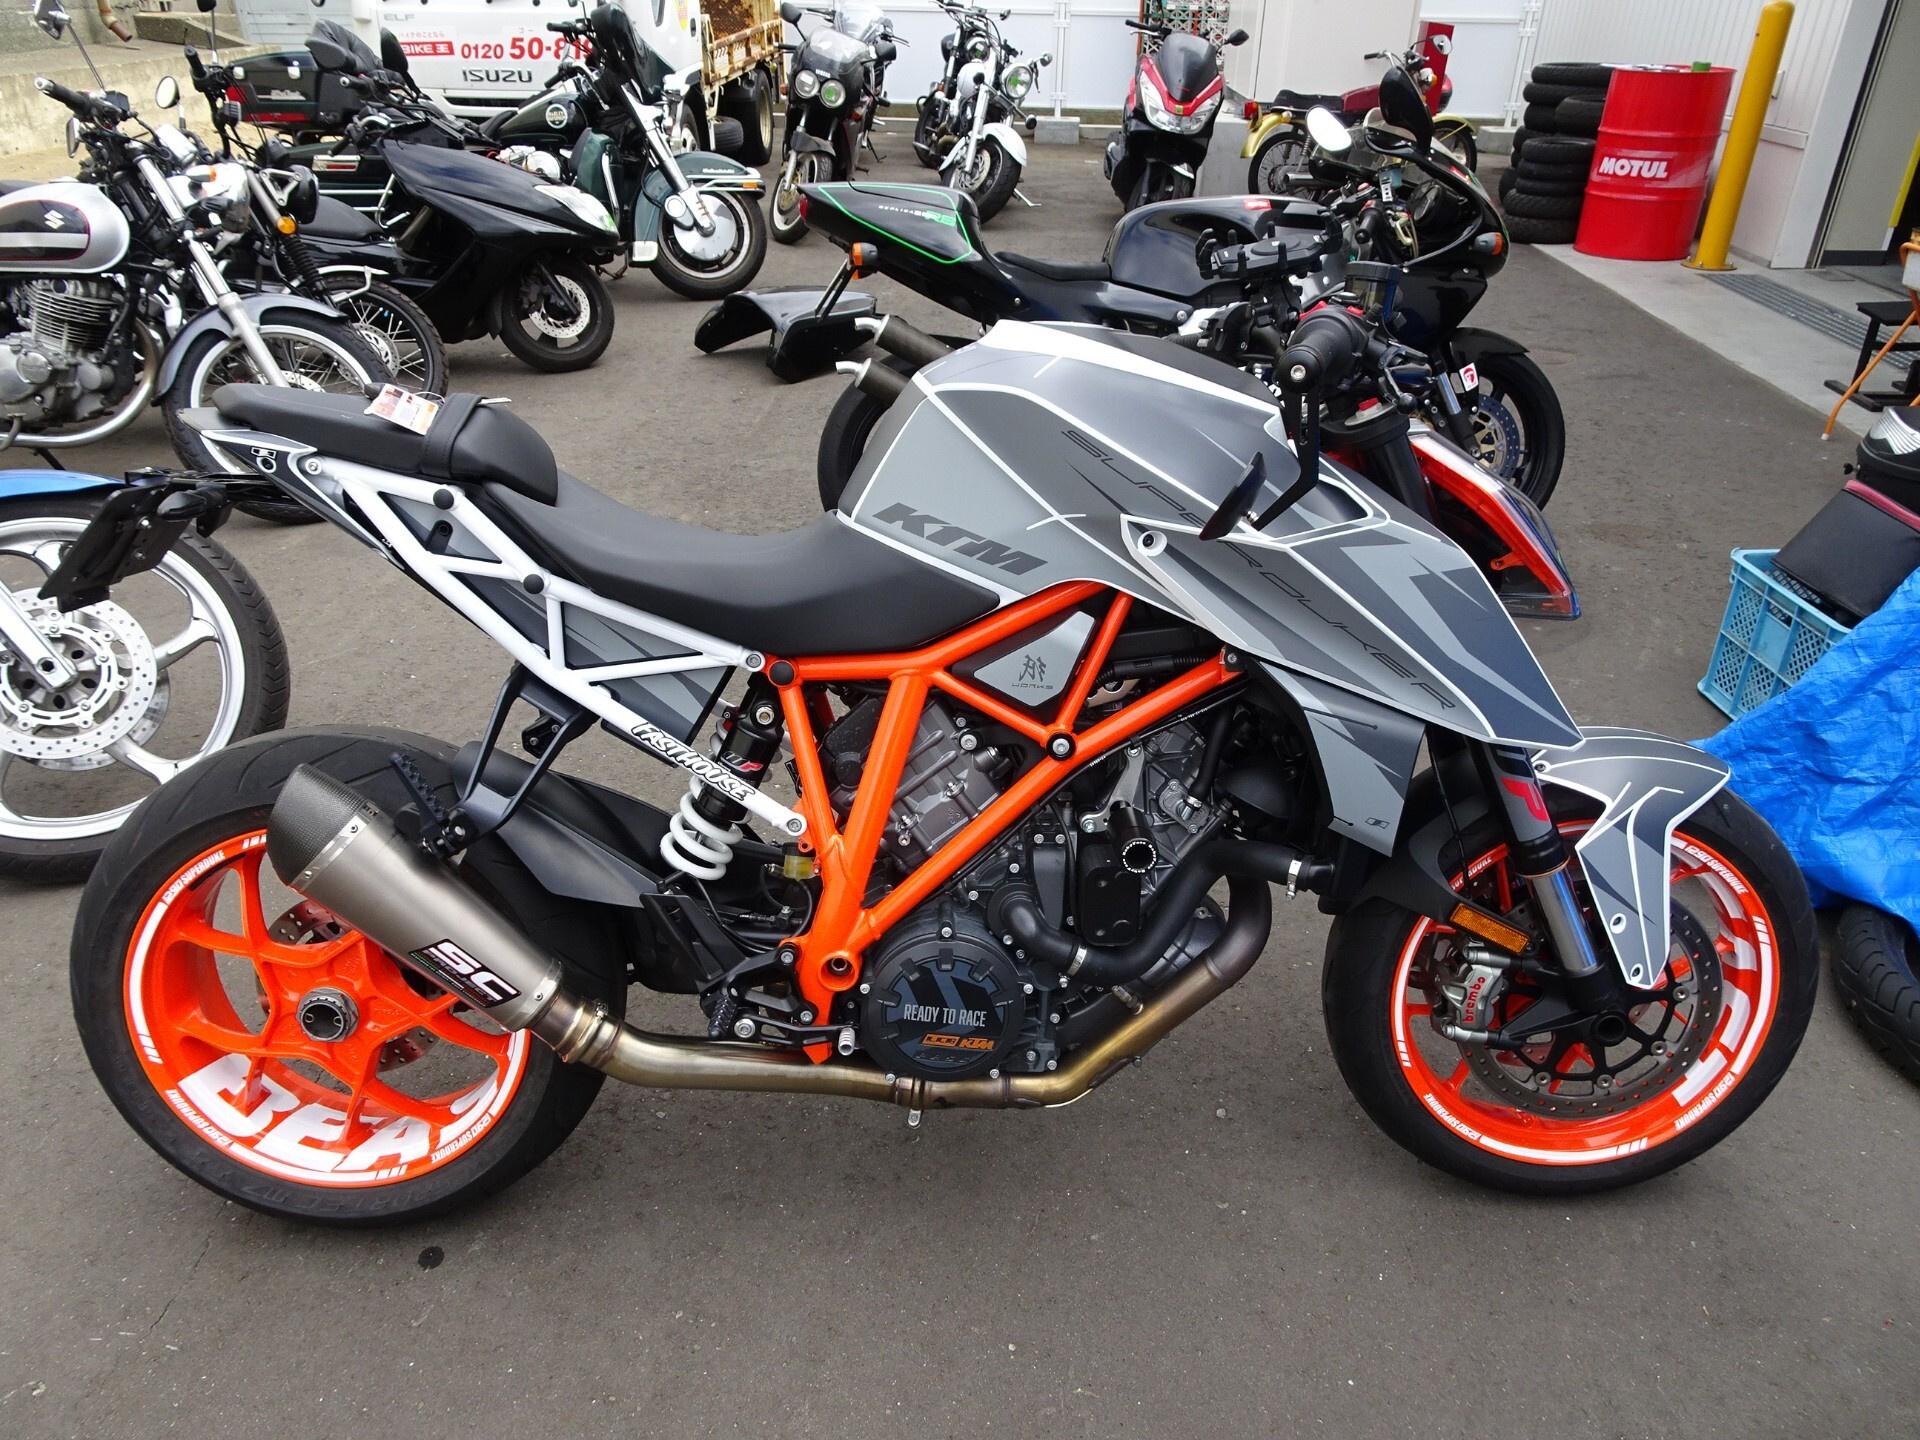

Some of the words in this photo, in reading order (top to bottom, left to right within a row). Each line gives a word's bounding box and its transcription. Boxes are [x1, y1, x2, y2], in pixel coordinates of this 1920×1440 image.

[384, 13, 415, 22] ELF
[461, 43, 504, 60] 0120
[462, 68, 533, 83] ISUZU
[1598, 157, 1669, 178] MOTUL
[872, 502, 1049, 576] KTM
[1410, 682, 1456, 710] R
[630, 721, 756, 802] FASTHOUSE
[429, 942, 518, 1001] SC
[1462, 976, 1486, 1023] brembo
[903, 1003, 940, 1023] READY
[942, 1007, 956, 1025] TO
[958, 1009, 988, 1027] RACE
[959, 1038, 994, 1051] KTM
